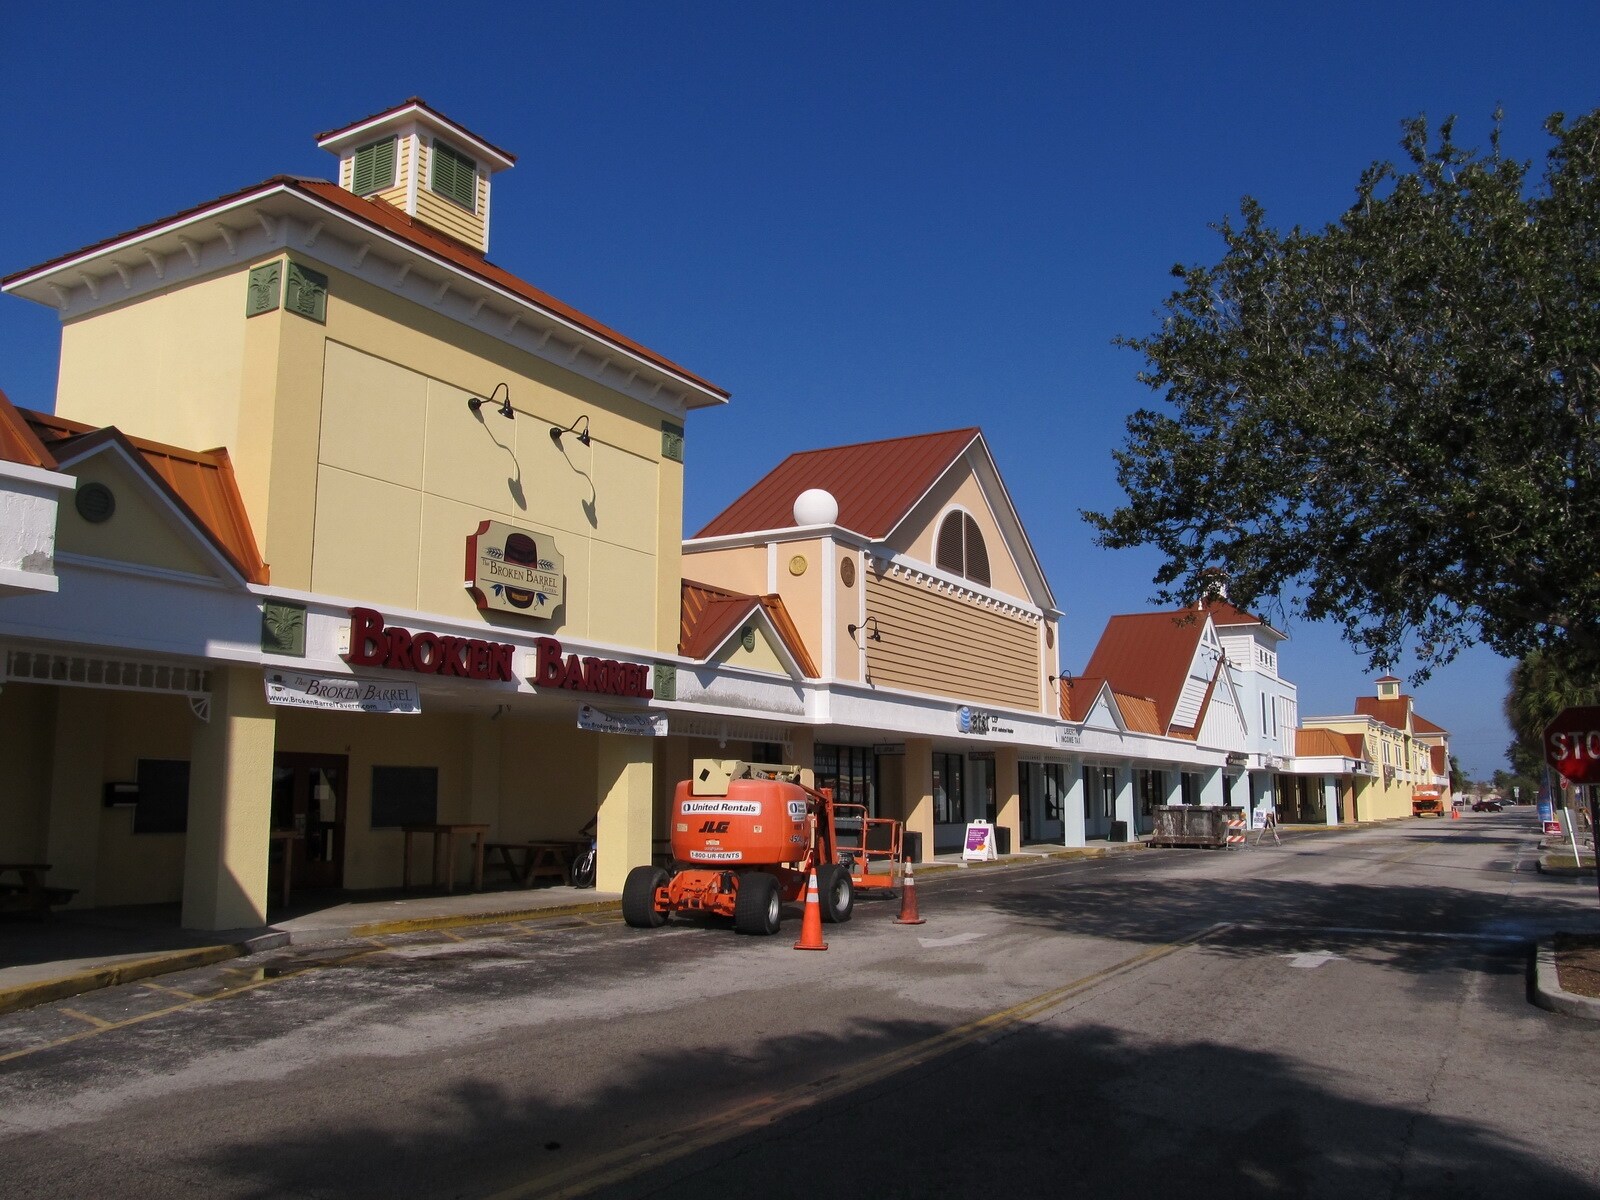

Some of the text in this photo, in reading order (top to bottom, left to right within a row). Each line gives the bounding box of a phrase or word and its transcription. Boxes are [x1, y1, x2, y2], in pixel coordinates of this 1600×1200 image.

[490, 560, 525, 581] BROKEN
[526, 569, 558, 588] BARREL
[347, 606, 653, 699] BROKEN BARREL
[269, 694, 377, 710] www.BrokenBarrelTavern.com
[305, 679, 363, 700] BROKEN
[363, 685, 412, 702] BARREL
[1550, 731, 1600, 761] STO
[692, 802, 756, 812] United Rentals
[698, 820, 731, 834] JLG
